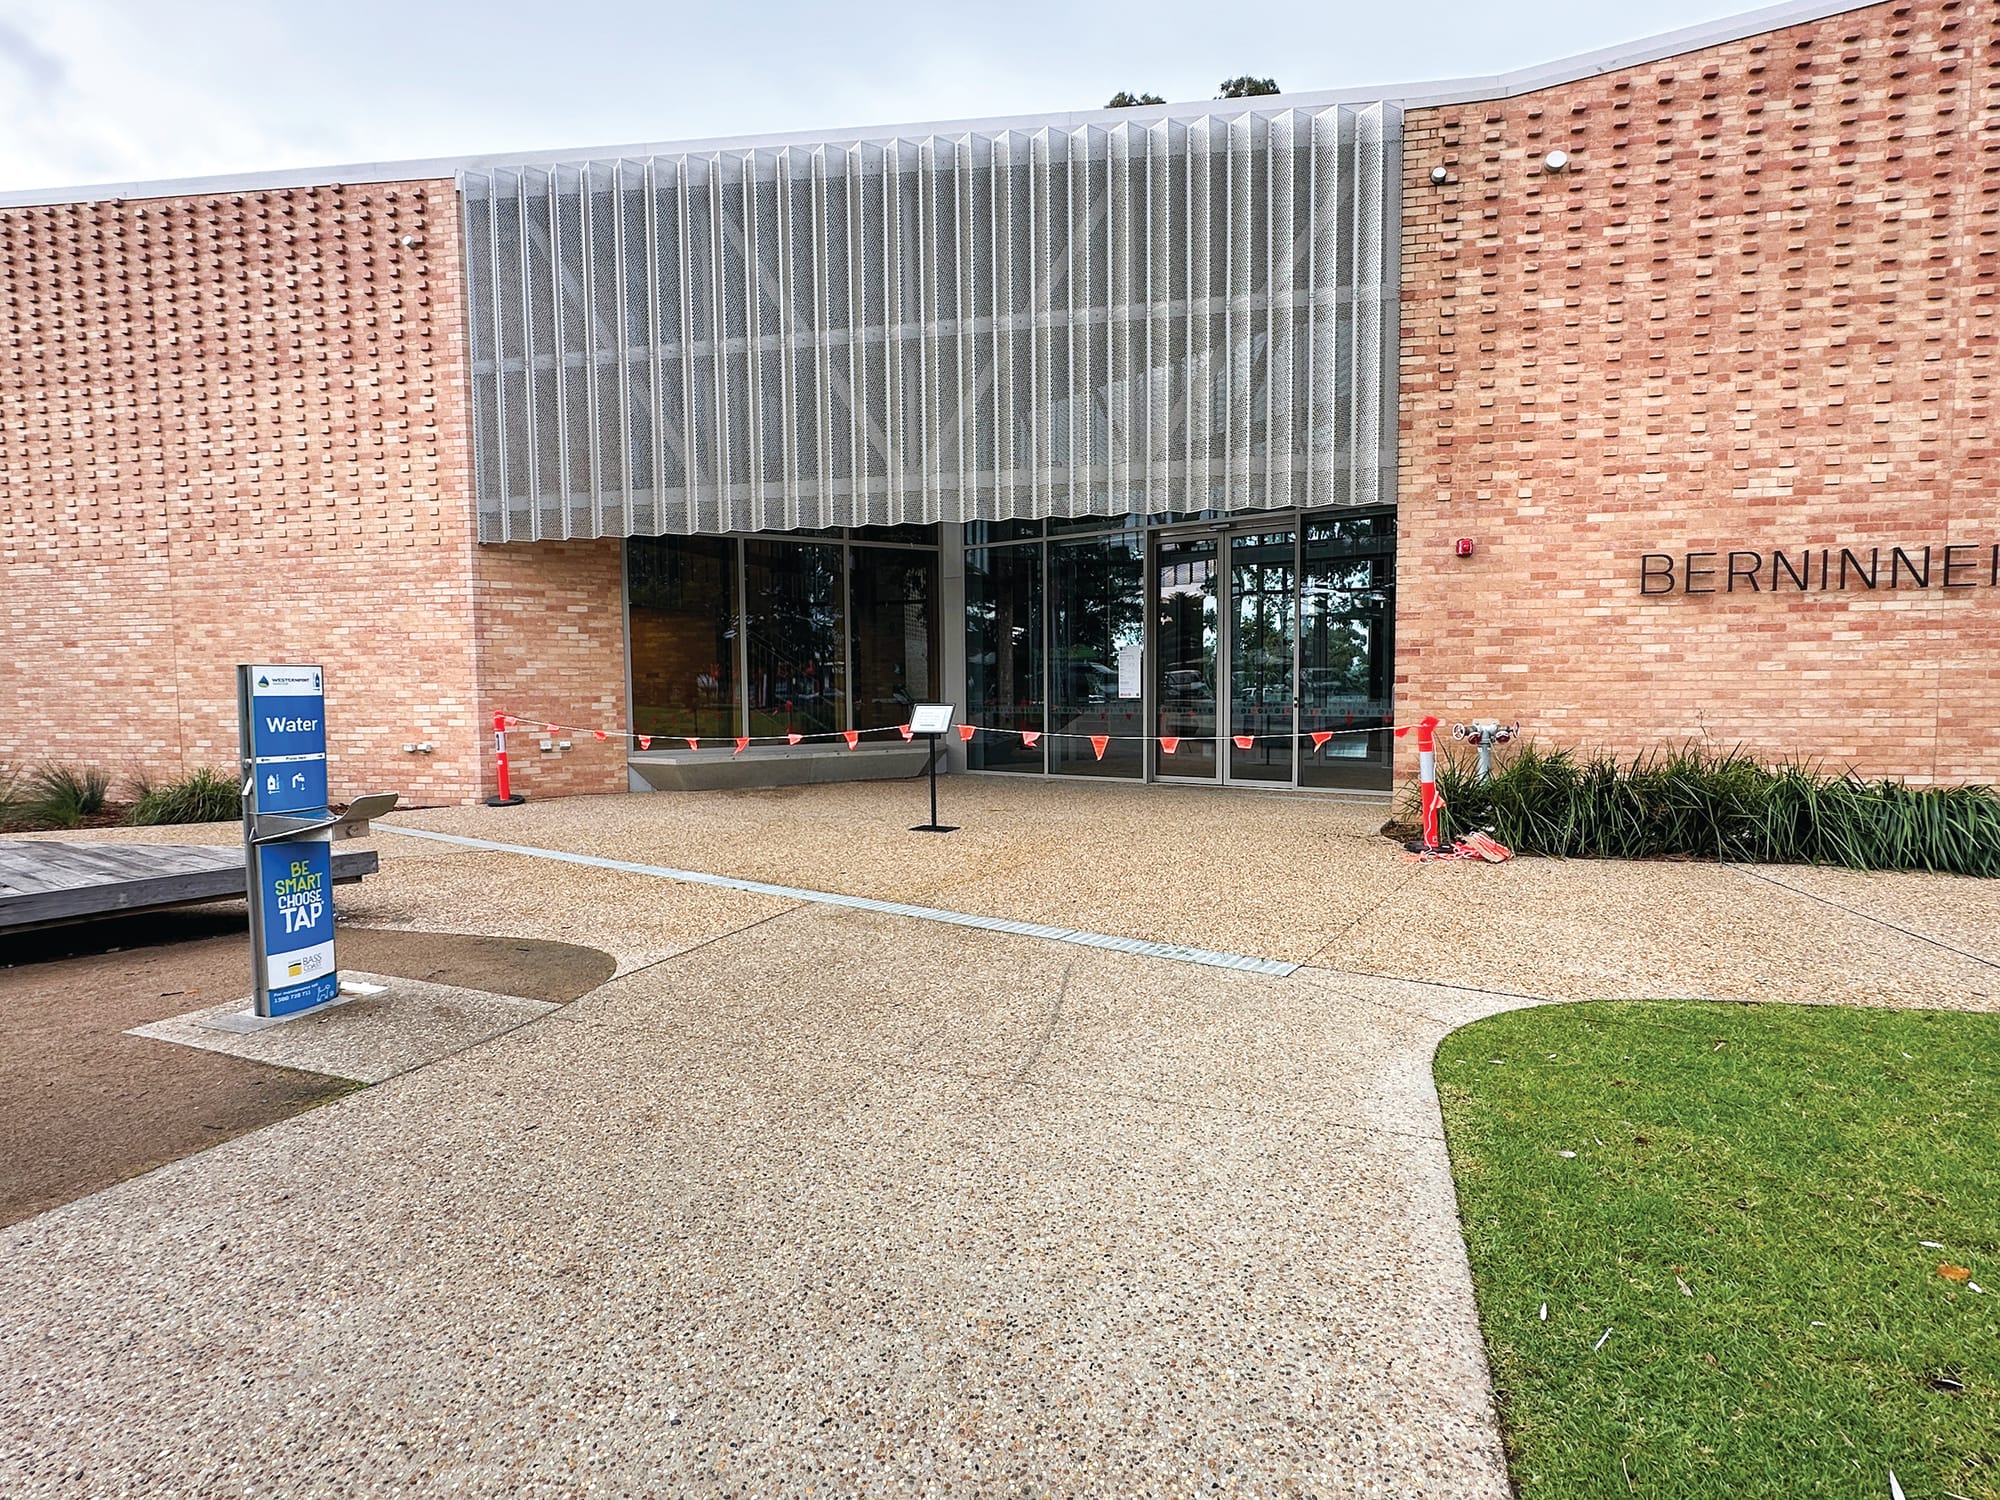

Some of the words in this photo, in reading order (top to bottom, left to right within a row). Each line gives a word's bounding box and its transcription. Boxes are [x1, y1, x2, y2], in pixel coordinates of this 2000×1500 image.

[266, 717, 318, 733] Water
[291, 860, 310, 878] BE
[275, 872, 323, 896] SMART
[278, 889, 322, 909] CHOOSE
[280, 902, 323, 933] TAP
[302, 953, 322, 966] BASS
